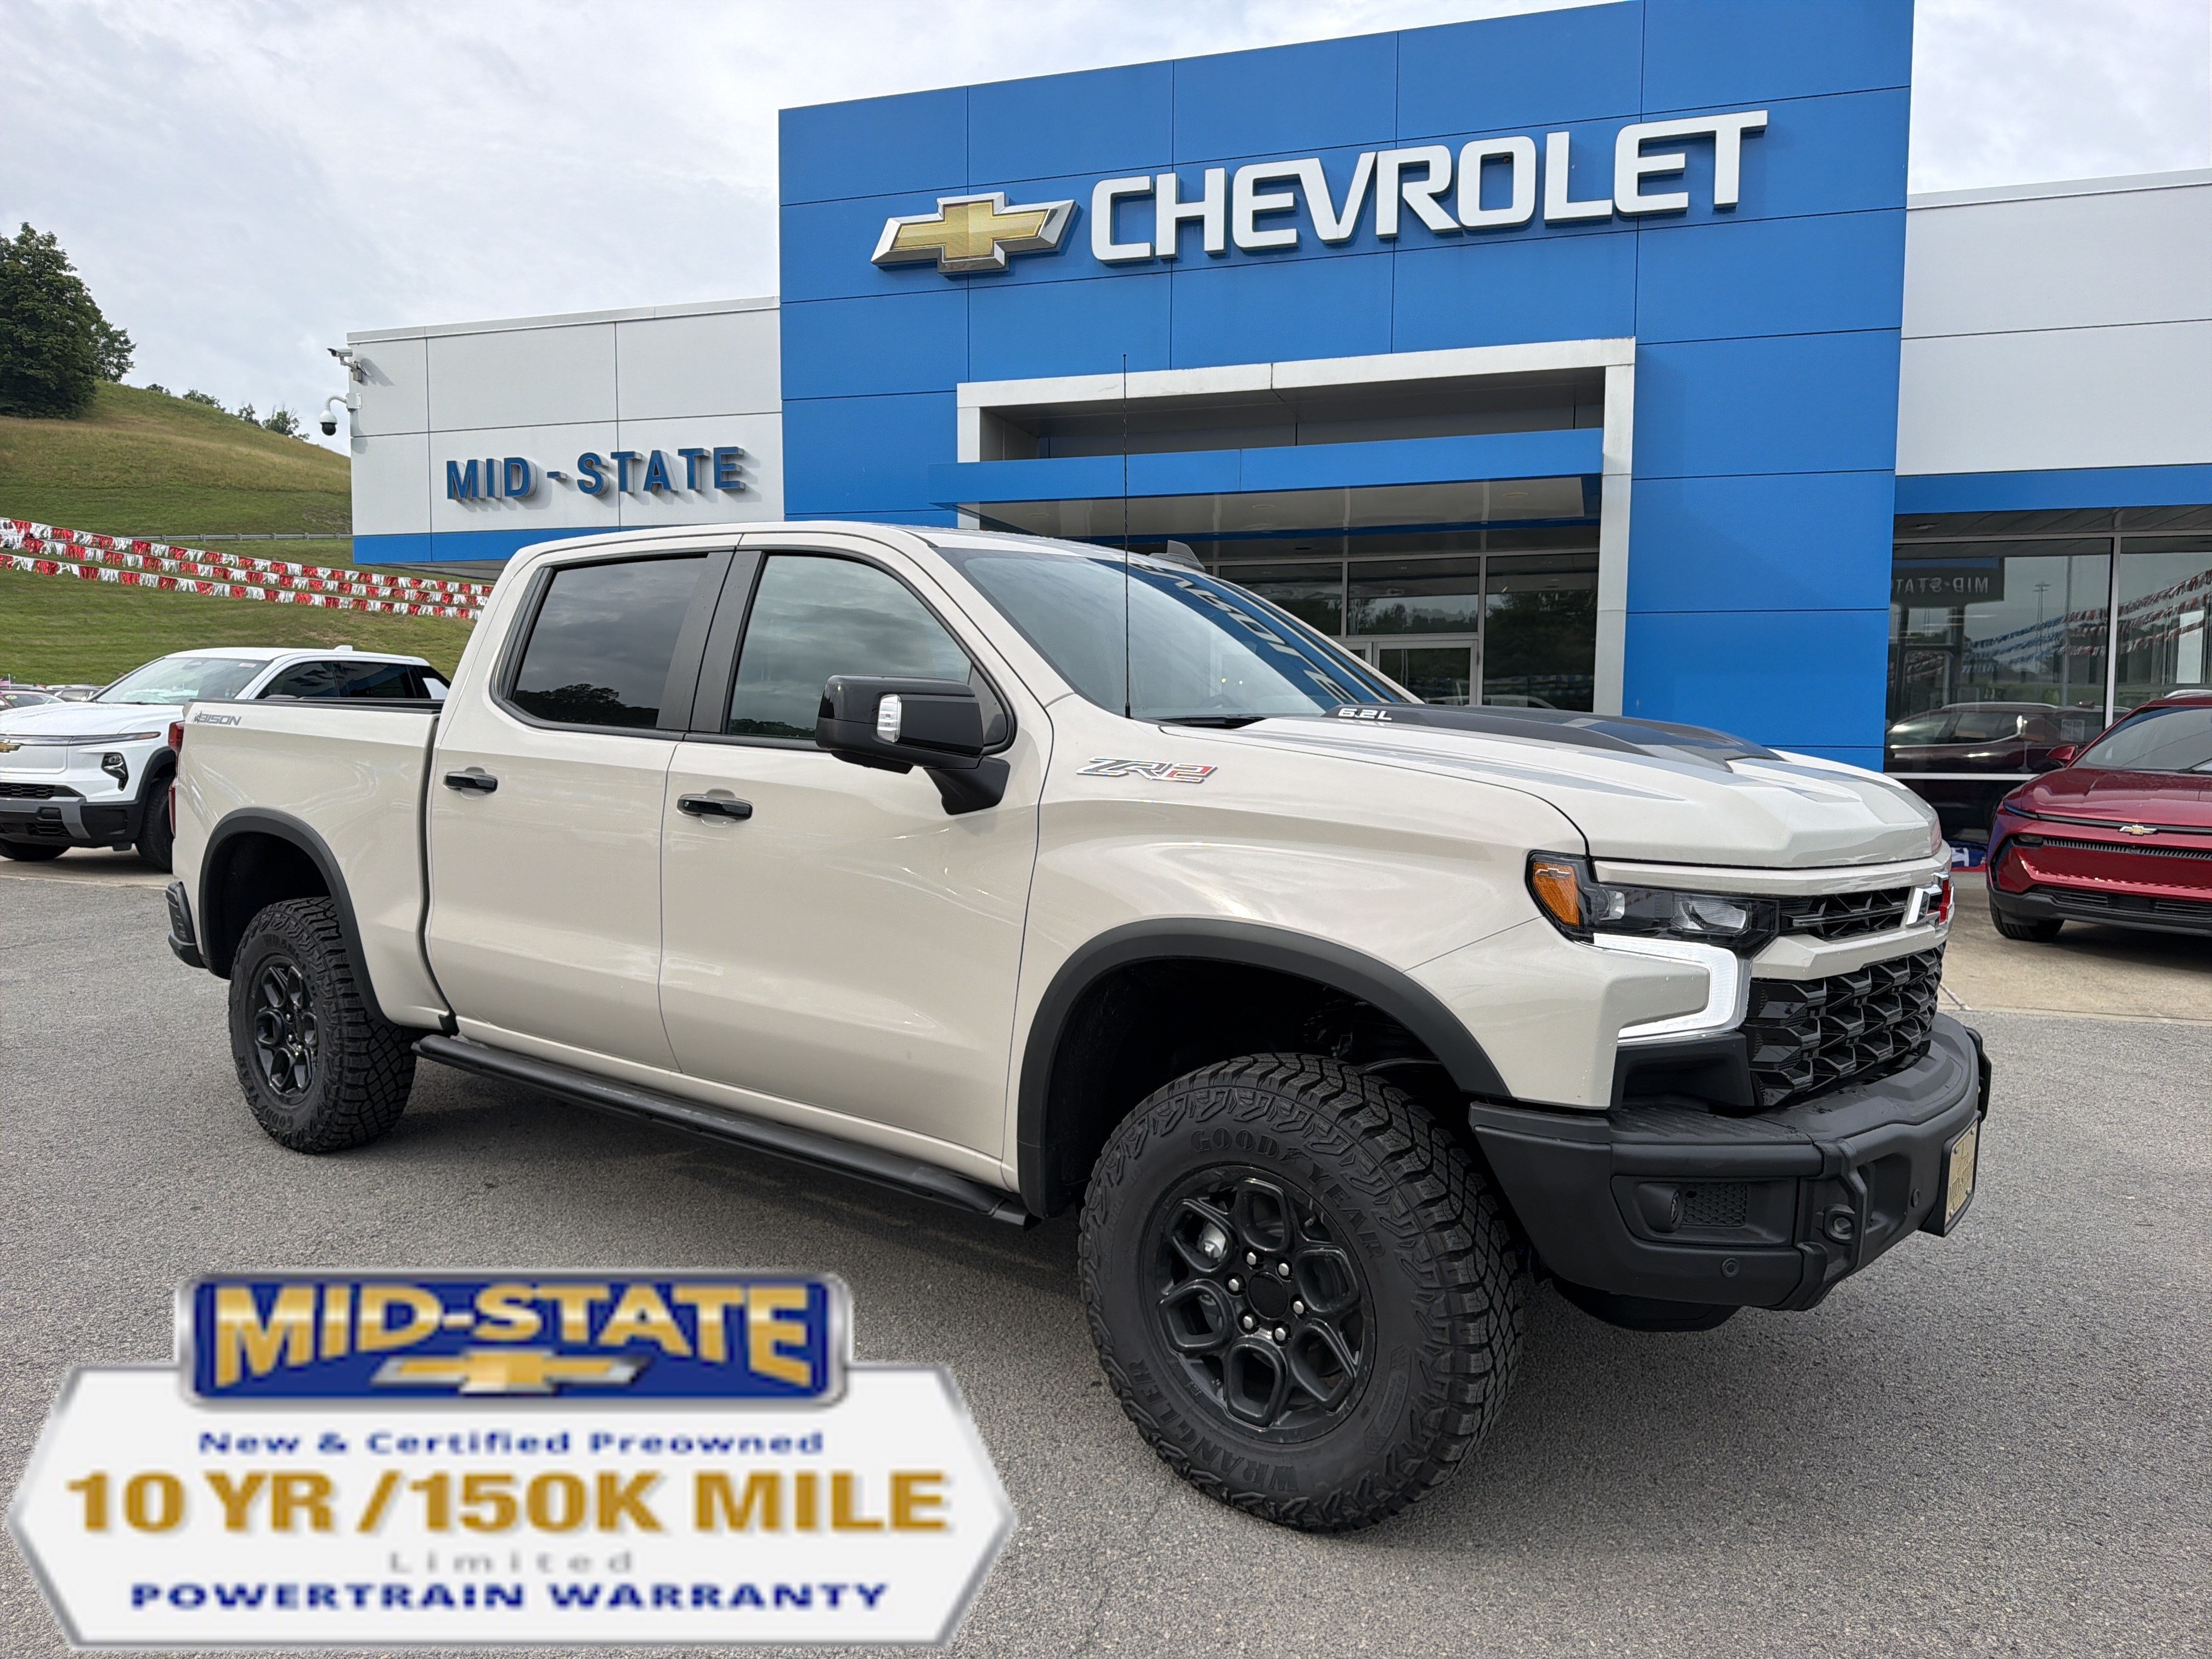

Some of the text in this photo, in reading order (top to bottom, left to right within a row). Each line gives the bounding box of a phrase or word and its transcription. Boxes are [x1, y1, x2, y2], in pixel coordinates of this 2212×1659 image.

[1091, 109, 1769, 263] CHEVROLET
[446, 447, 744, 500] MID-STATE
[198, 713, 242, 726] BISON
[1338, 708, 1392, 721] 6.2L
[1075, 757, 1218, 783] ZR2
[1128, 1357, 1299, 1491] WRANGLER
